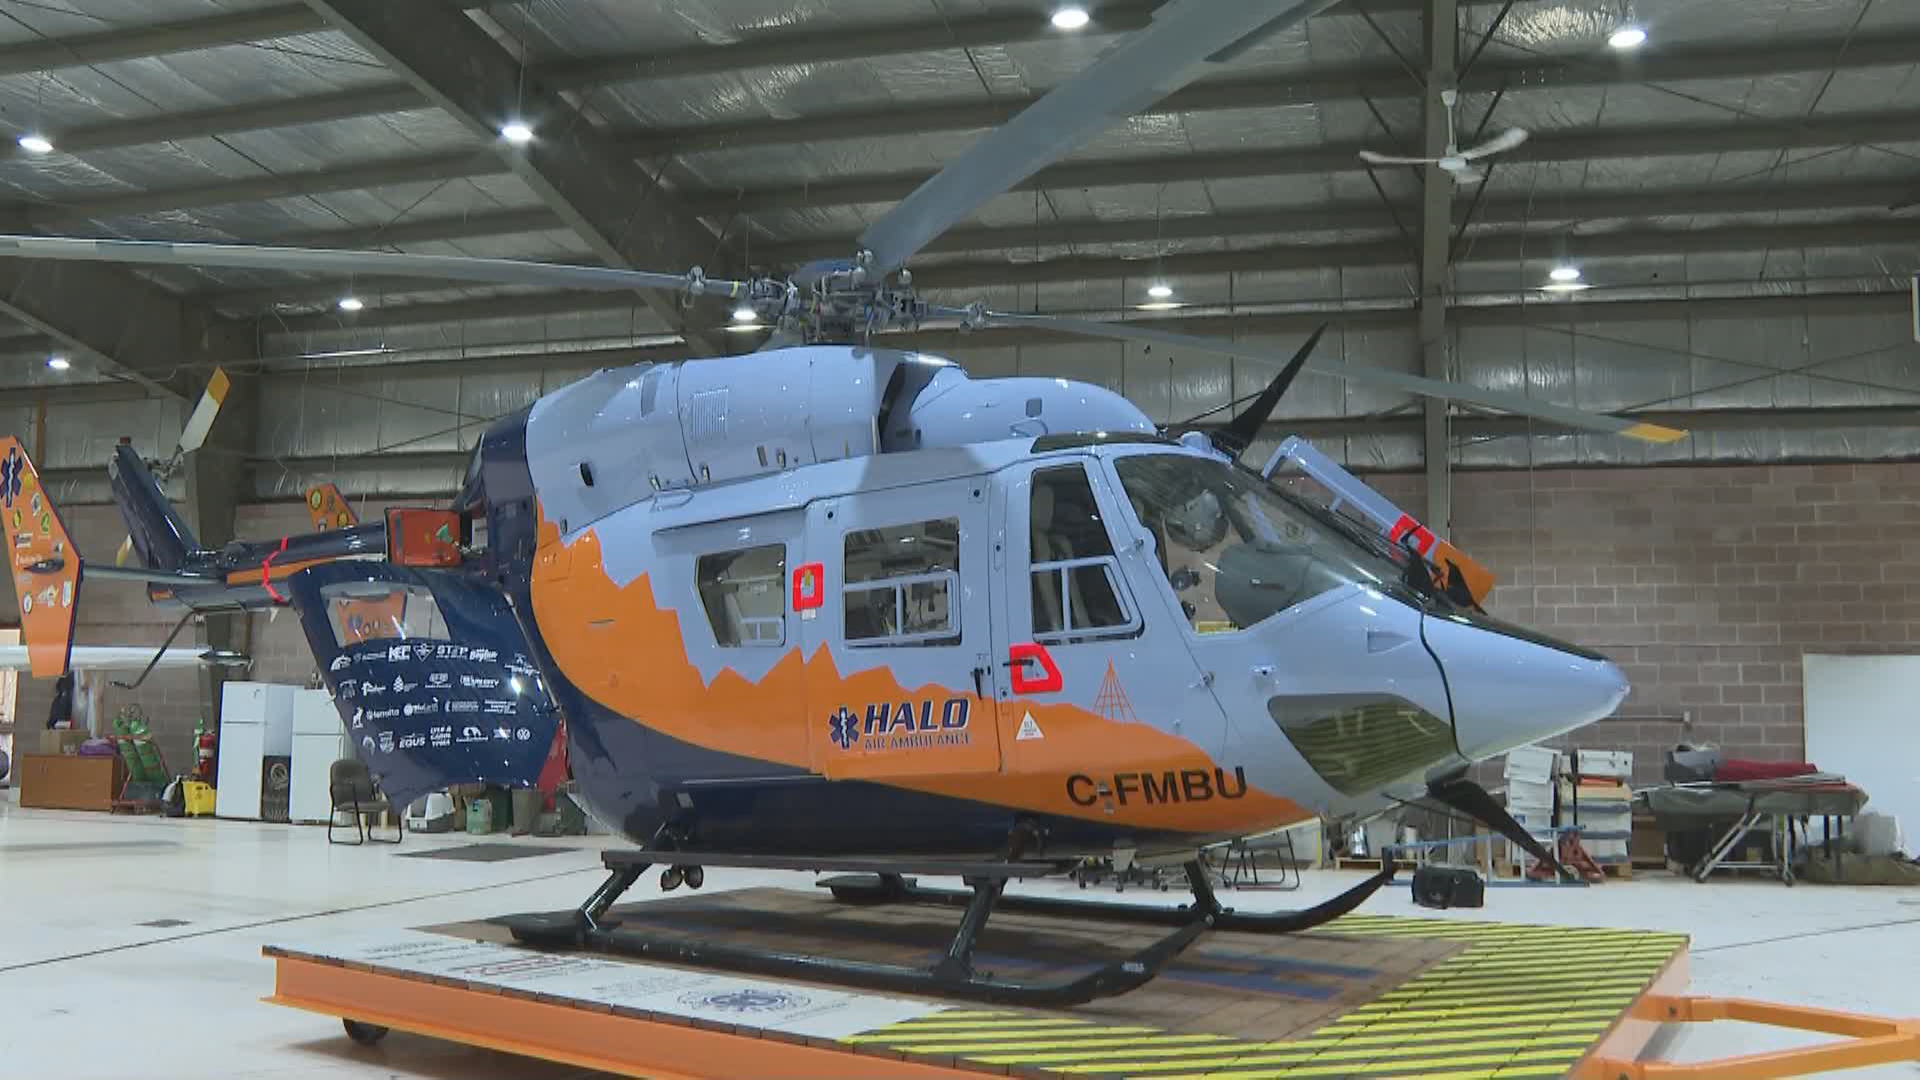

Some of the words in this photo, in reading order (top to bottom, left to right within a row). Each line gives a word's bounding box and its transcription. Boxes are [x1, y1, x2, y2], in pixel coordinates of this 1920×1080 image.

[863, 697, 971, 736] HALO
[864, 738, 887, 752] AIR
[891, 732, 972, 751] AMBULANCE
[1066, 765, 1248, 807] C-FMBU
